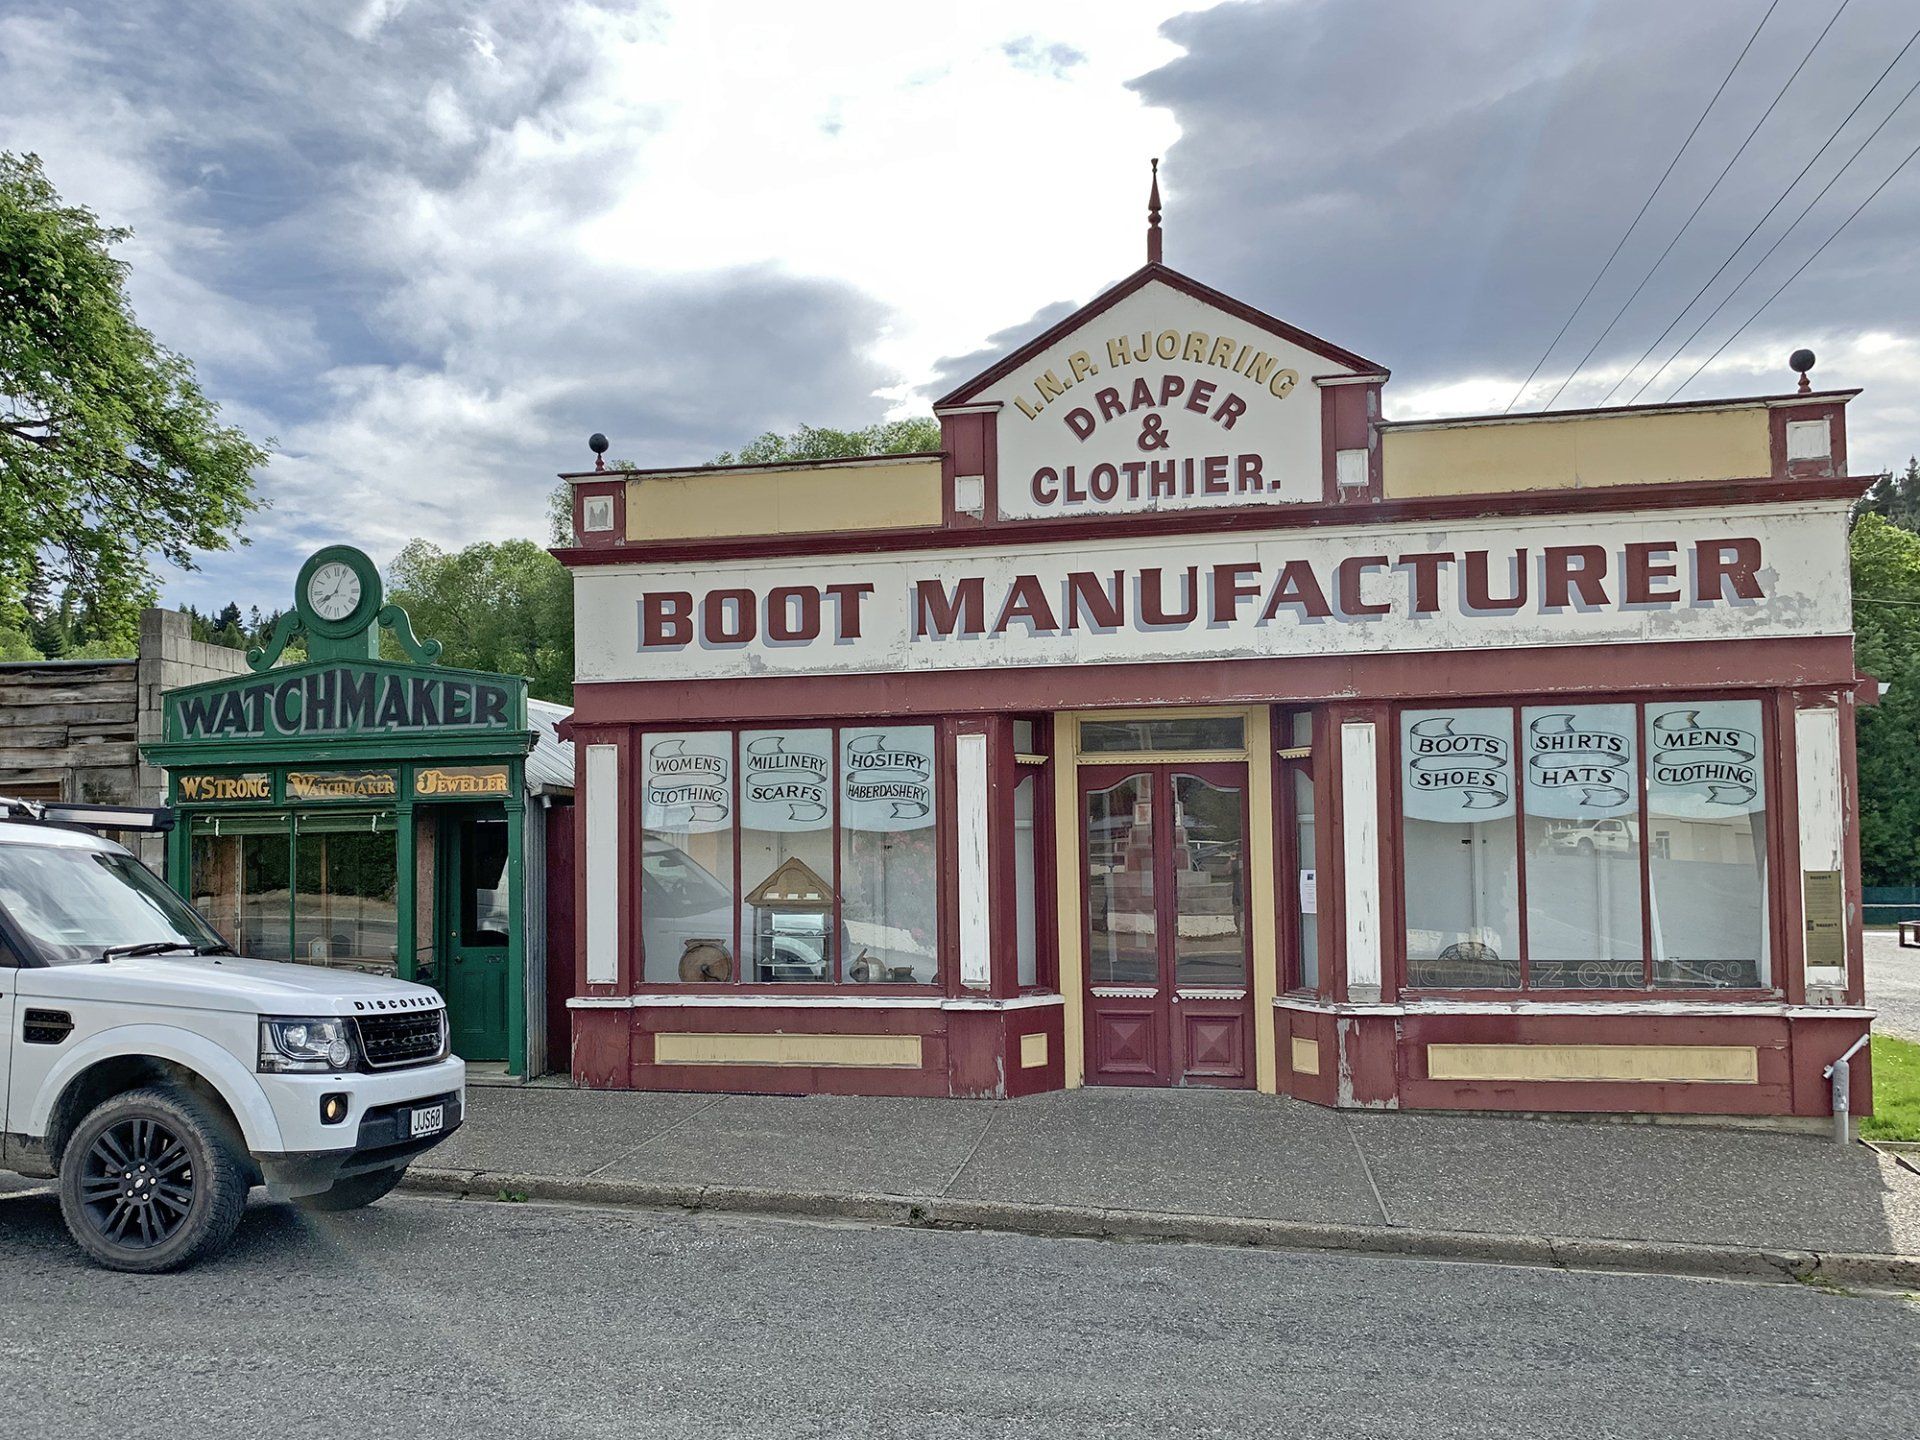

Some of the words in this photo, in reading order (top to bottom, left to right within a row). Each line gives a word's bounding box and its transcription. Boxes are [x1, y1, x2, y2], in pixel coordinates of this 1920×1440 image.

[1106, 329, 1300, 399] HJORRING
[1063, 375, 1247, 442] DRAPER
[1137, 413, 1170, 452] &
[1031, 453, 1282, 505] CLOTHIER.
[637, 582, 875, 653] BOOT
[909, 537, 1767, 644] MANUFACTURER
[178, 669, 509, 739] WATCHMAKER
[1418, 736, 1499, 753] BOOTS
[1536, 734, 1622, 752] SHIRTS
[1663, 731, 1740, 747] MENS
[656, 757, 721, 772] WOMENS
[749, 755, 827, 771] MILLINERY
[851, 753, 926, 769] HOSIERY
[416, 770, 508, 794] JEWELLER
[1417, 771, 1497, 787] SHOES
[1541, 768, 1615, 785] HATS
[1658, 764, 1753, 783] CLOTHING
[651, 787, 723, 803] CLOTHING
[752, 785, 822, 802] SCARFS
[848, 784, 927, 801] HABERDASHERY
[353, 996, 438, 1011] DISCOVERY
[414, 1108, 441, 1132] JJS60
